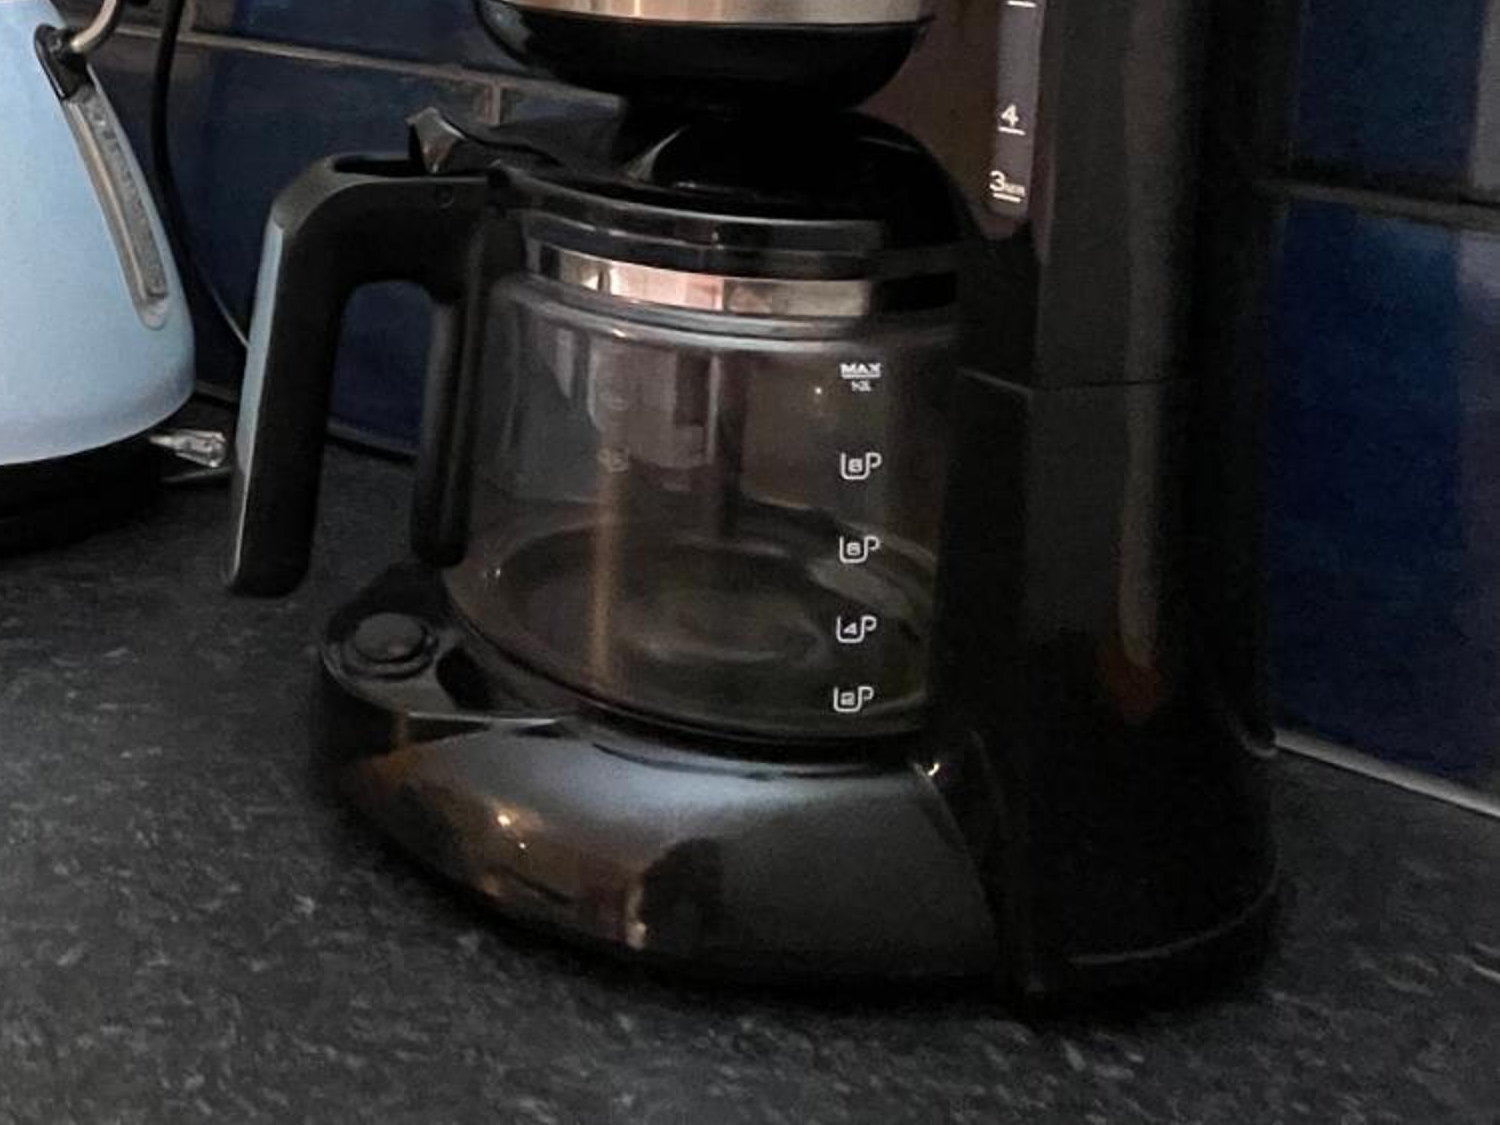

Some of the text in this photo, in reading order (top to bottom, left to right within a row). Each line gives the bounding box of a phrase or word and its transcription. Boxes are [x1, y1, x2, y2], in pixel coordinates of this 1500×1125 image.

[1000, 103, 1019, 127] 4
[839, 362, 882, 374] MAX
[843, 621, 857, 635] 4
